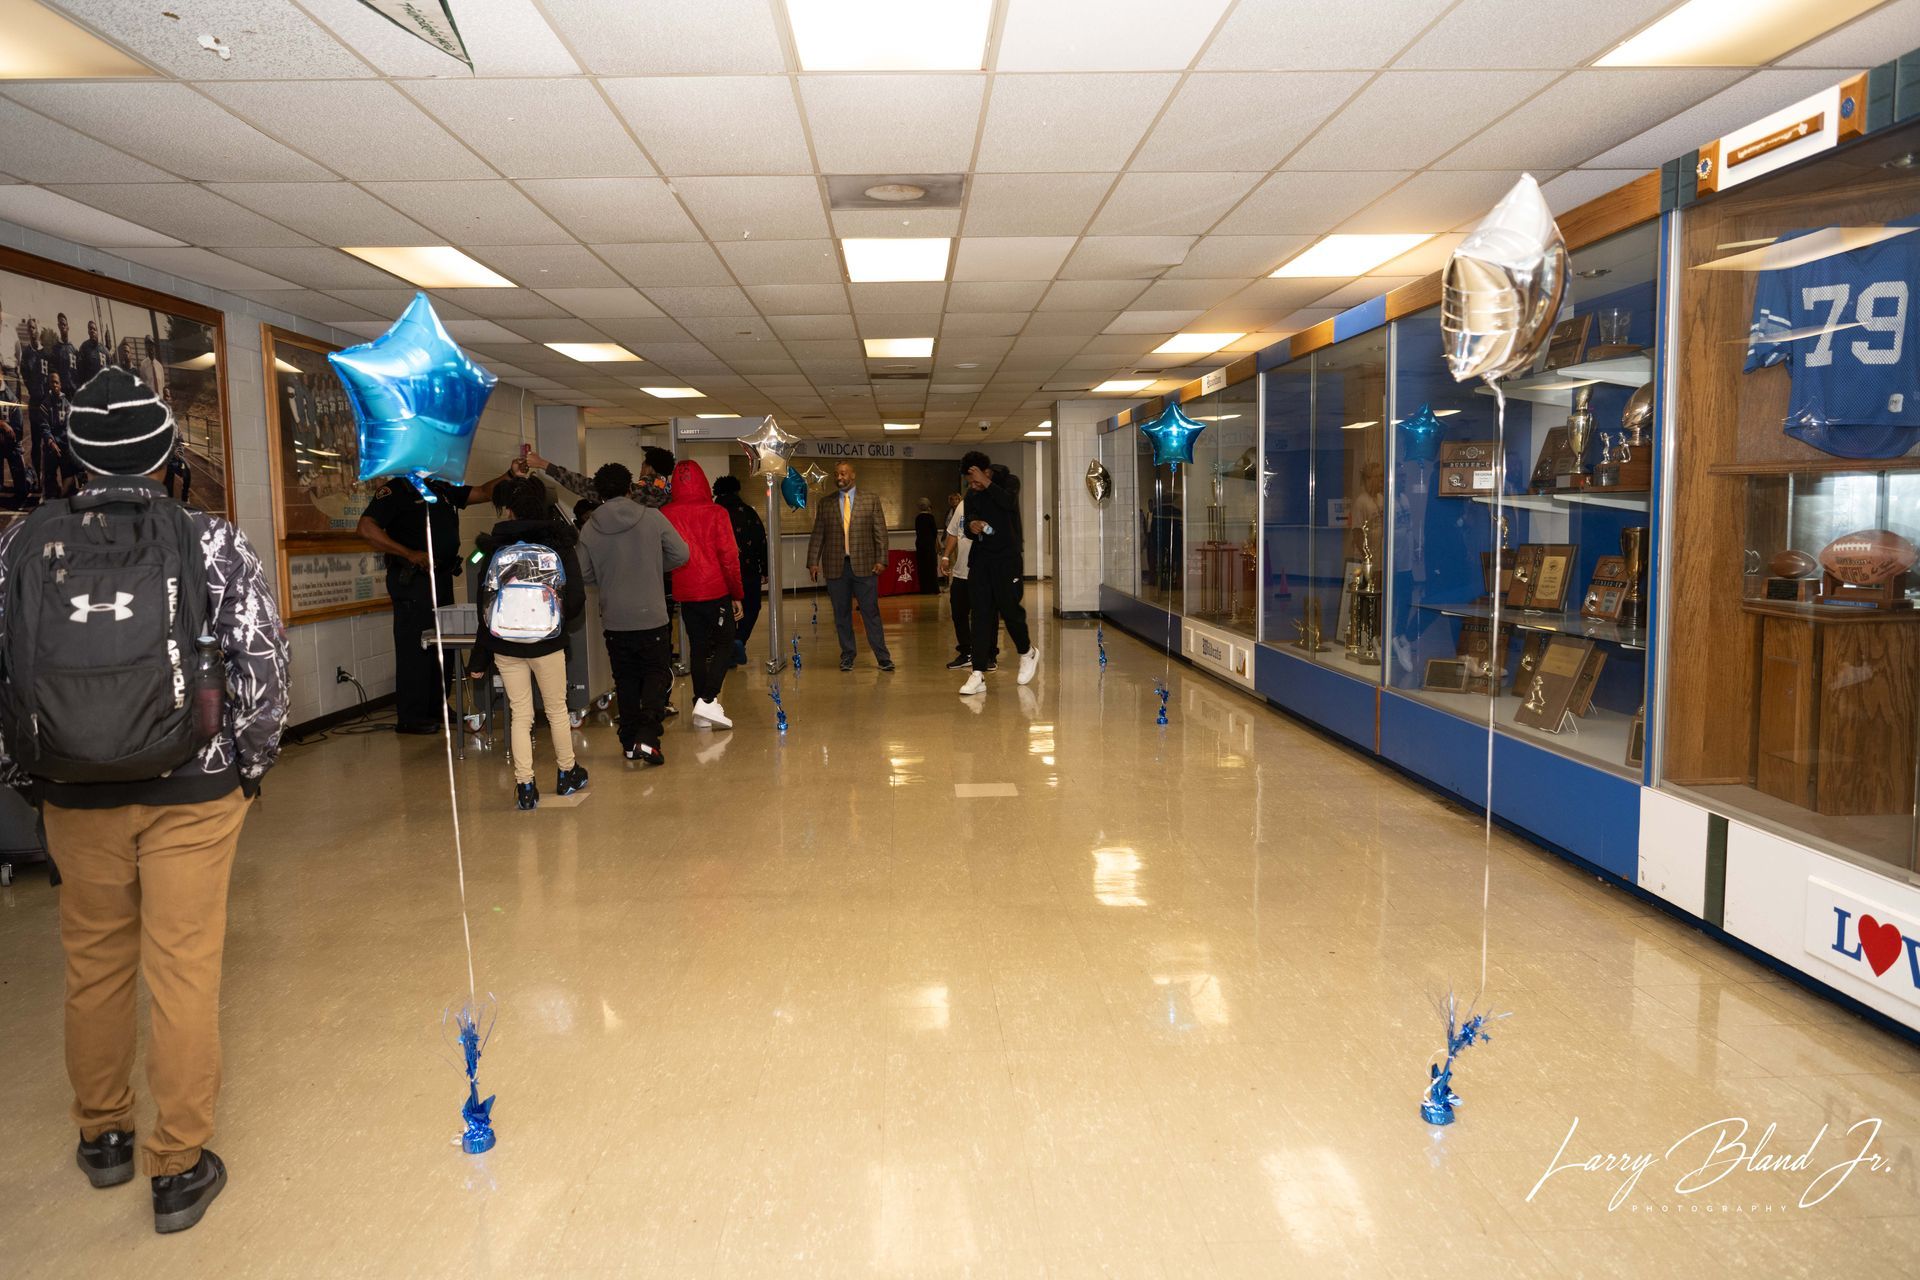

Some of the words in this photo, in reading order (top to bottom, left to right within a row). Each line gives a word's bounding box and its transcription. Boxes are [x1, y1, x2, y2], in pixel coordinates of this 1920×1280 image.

[1802, 281, 1909, 367] 79
[817, 443, 865, 456] WILDCAT
[867, 443, 895, 457] GRUB
[167, 639, 186, 709] ARMOUR
